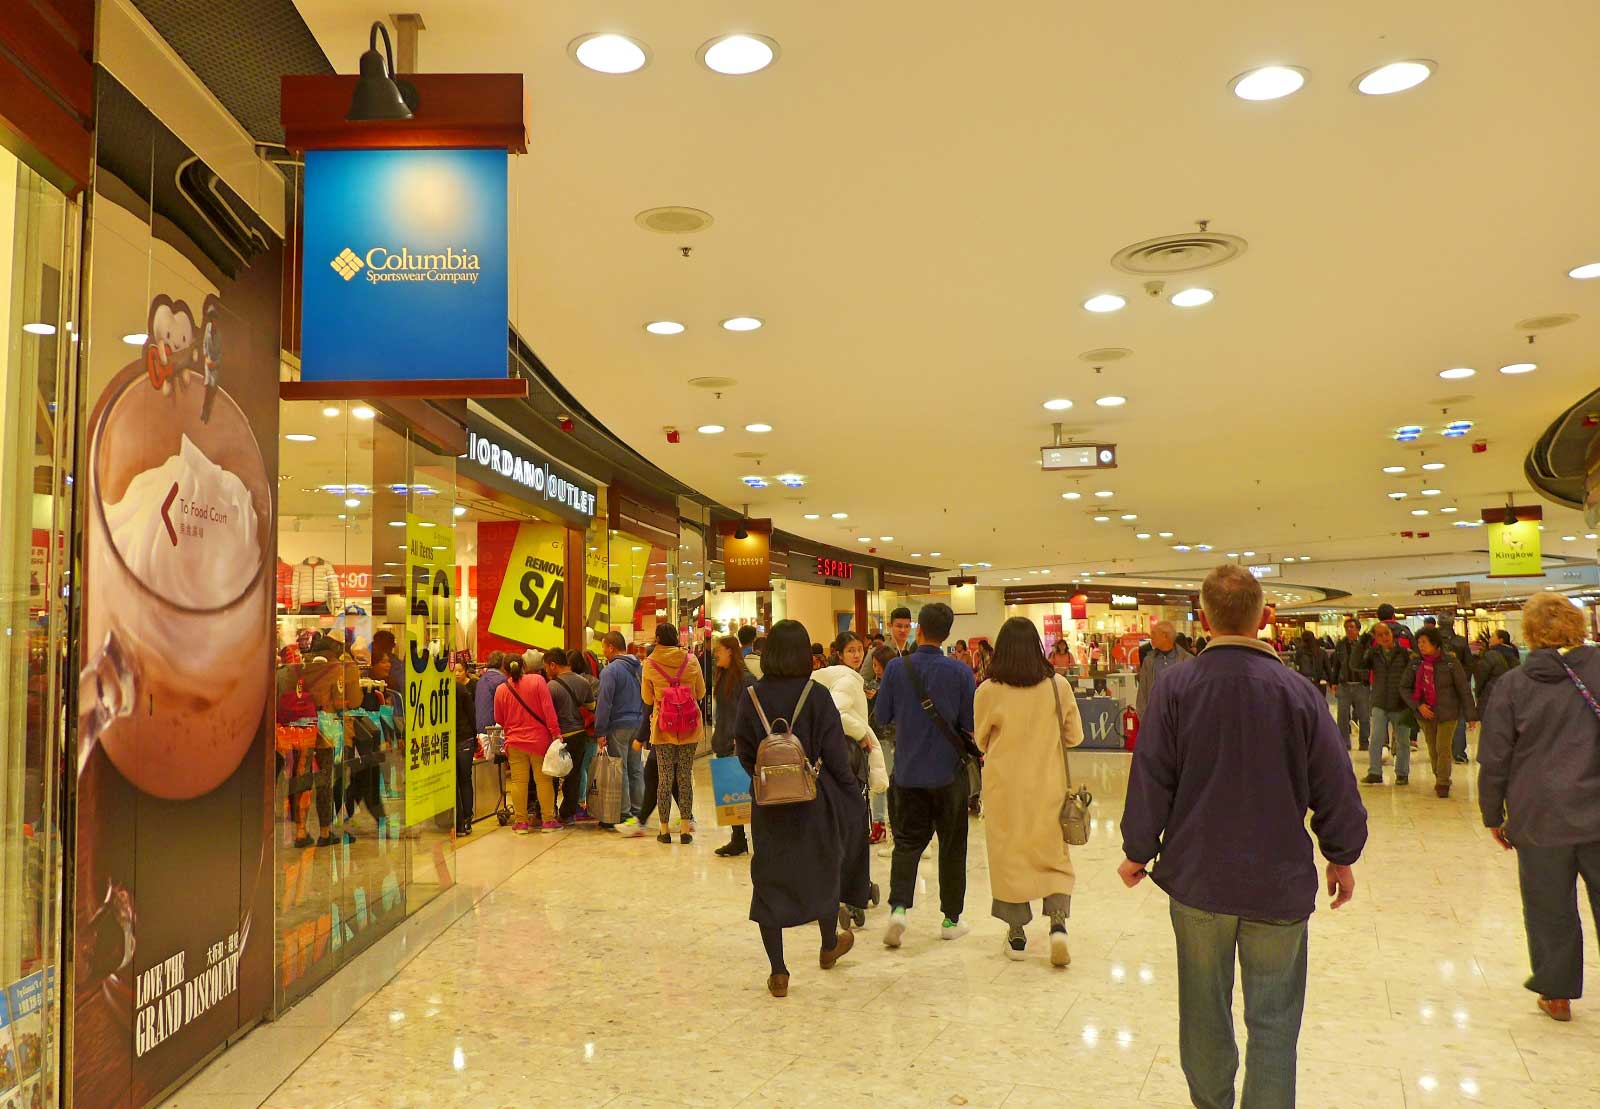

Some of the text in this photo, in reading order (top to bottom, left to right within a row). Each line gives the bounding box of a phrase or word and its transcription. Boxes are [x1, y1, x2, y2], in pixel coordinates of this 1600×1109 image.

[366, 247, 480, 270] Columbia
[366, 270, 479, 284] Sportswear Company
[180, 498, 227, 524] To Food Court
[547, 474, 596, 516] OUTLET
[410, 538, 434, 561] All items
[1495, 551, 1534, 560] Kingkow
[817, 556, 853, 580] ESPRIT
[409, 565, 450, 674] 50
[429, 677, 450, 727] off
[410, 731, 450, 771] 全場半價
[136, 950, 185, 1010] LOVE THE
[136, 988, 182, 1058] GRAND
[184, 950, 239, 1025] DISCOUNT
